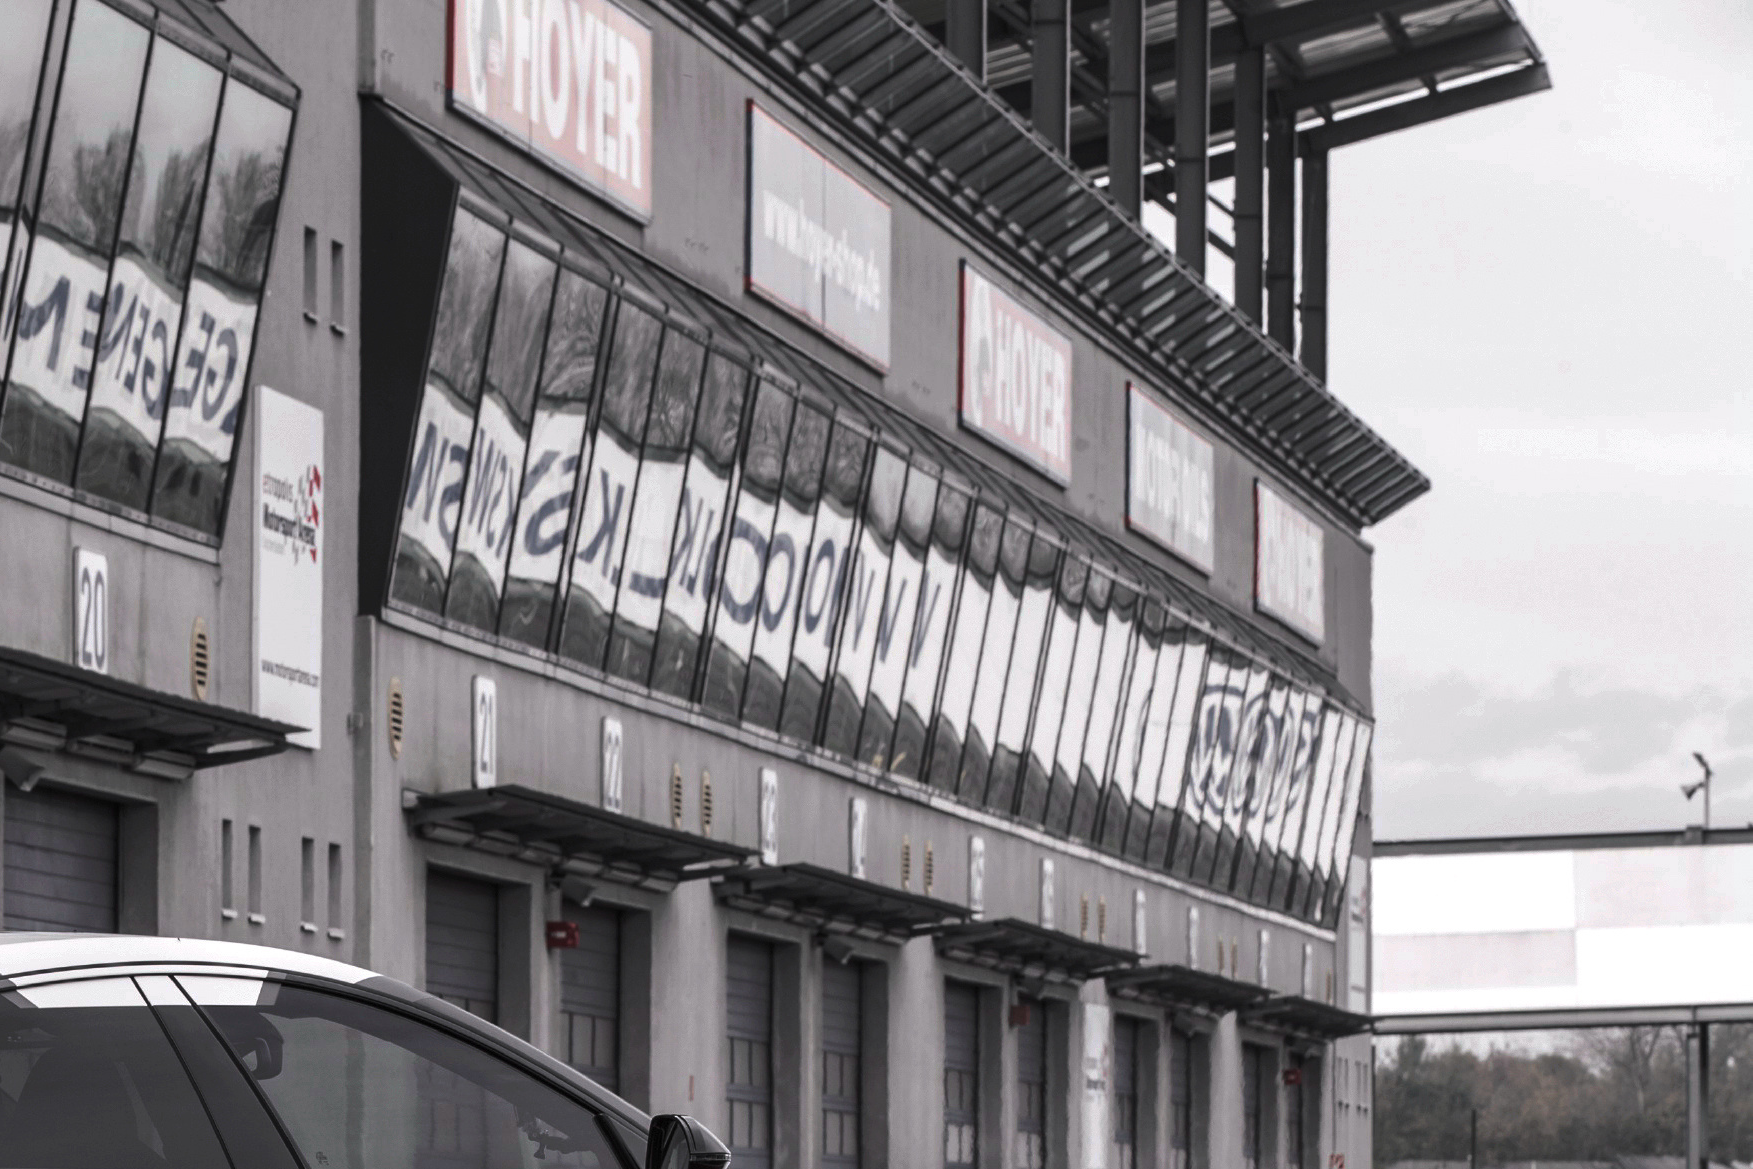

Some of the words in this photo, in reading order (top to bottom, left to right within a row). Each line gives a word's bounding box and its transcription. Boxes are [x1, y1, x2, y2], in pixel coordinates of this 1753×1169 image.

[513, 0, 642, 190] HOYER
[997, 309, 1066, 462] HOYER
[81, 567, 106, 671] 20
